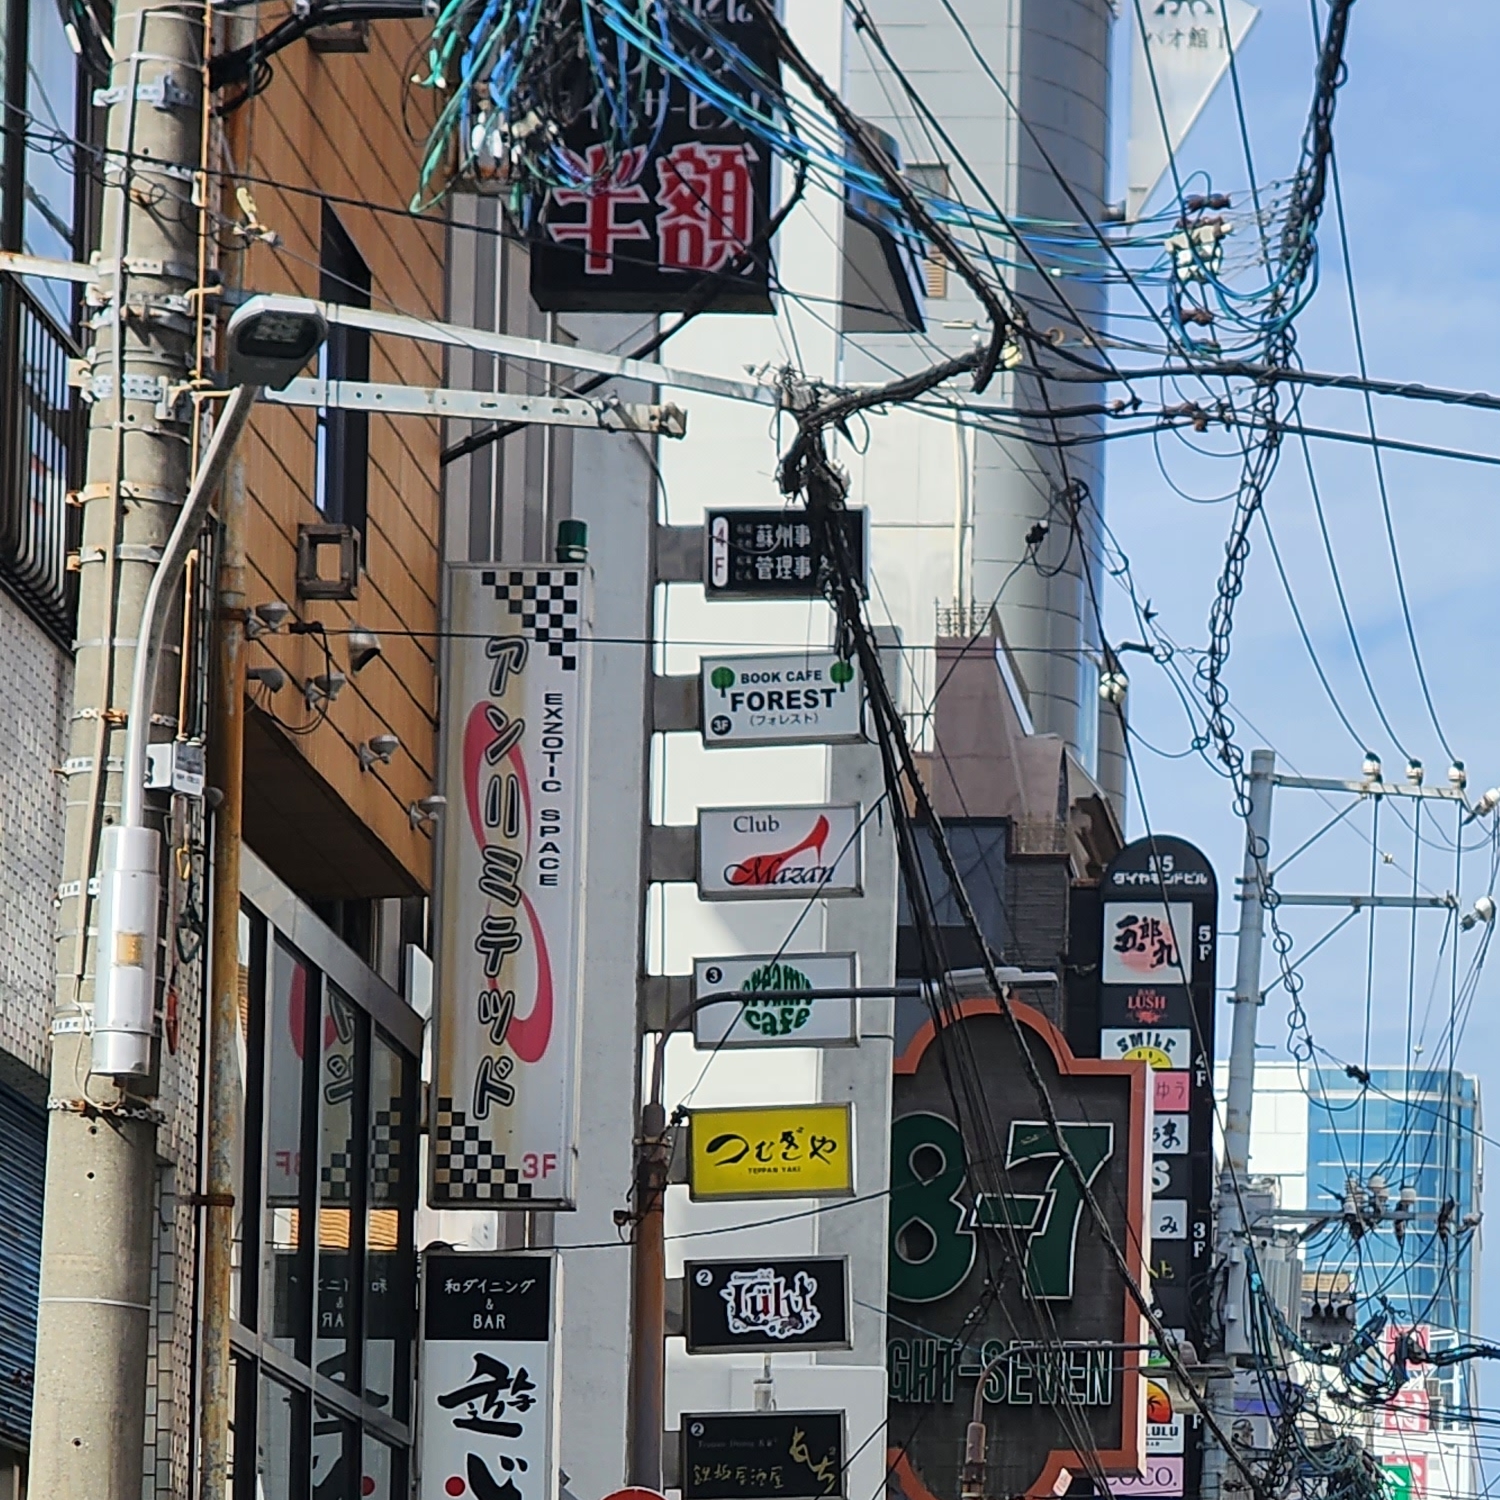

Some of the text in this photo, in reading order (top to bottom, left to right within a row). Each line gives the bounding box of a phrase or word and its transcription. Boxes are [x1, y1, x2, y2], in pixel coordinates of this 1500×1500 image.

[548, 142, 760, 275] 半額
[740, 667, 823, 685] BOOK CAFE
[730, 687, 837, 713] FOREST
[713, 715, 732, 733] 3F
[733, 814, 780, 833] Club
[537, 808, 562, 887] SPACE
[723, 860, 834, 886] Mazan
[1112, 872, 1208, 886] ダイヤモンドビル
[1197, 924, 1212, 962] 5F
[1127, 995, 1167, 1011] LUSH
[744, 1008, 811, 1036] cafe
[1116, 1032, 1177, 1054] SMILE
[522, 1153, 558, 1179] 3F
[1193, 1221, 1206, 1258] 3F
[444, 1278, 536, 1295] 和ダイニング
[485, 1298, 495, 1311] &
[473, 1313, 506, 1330] BAR
